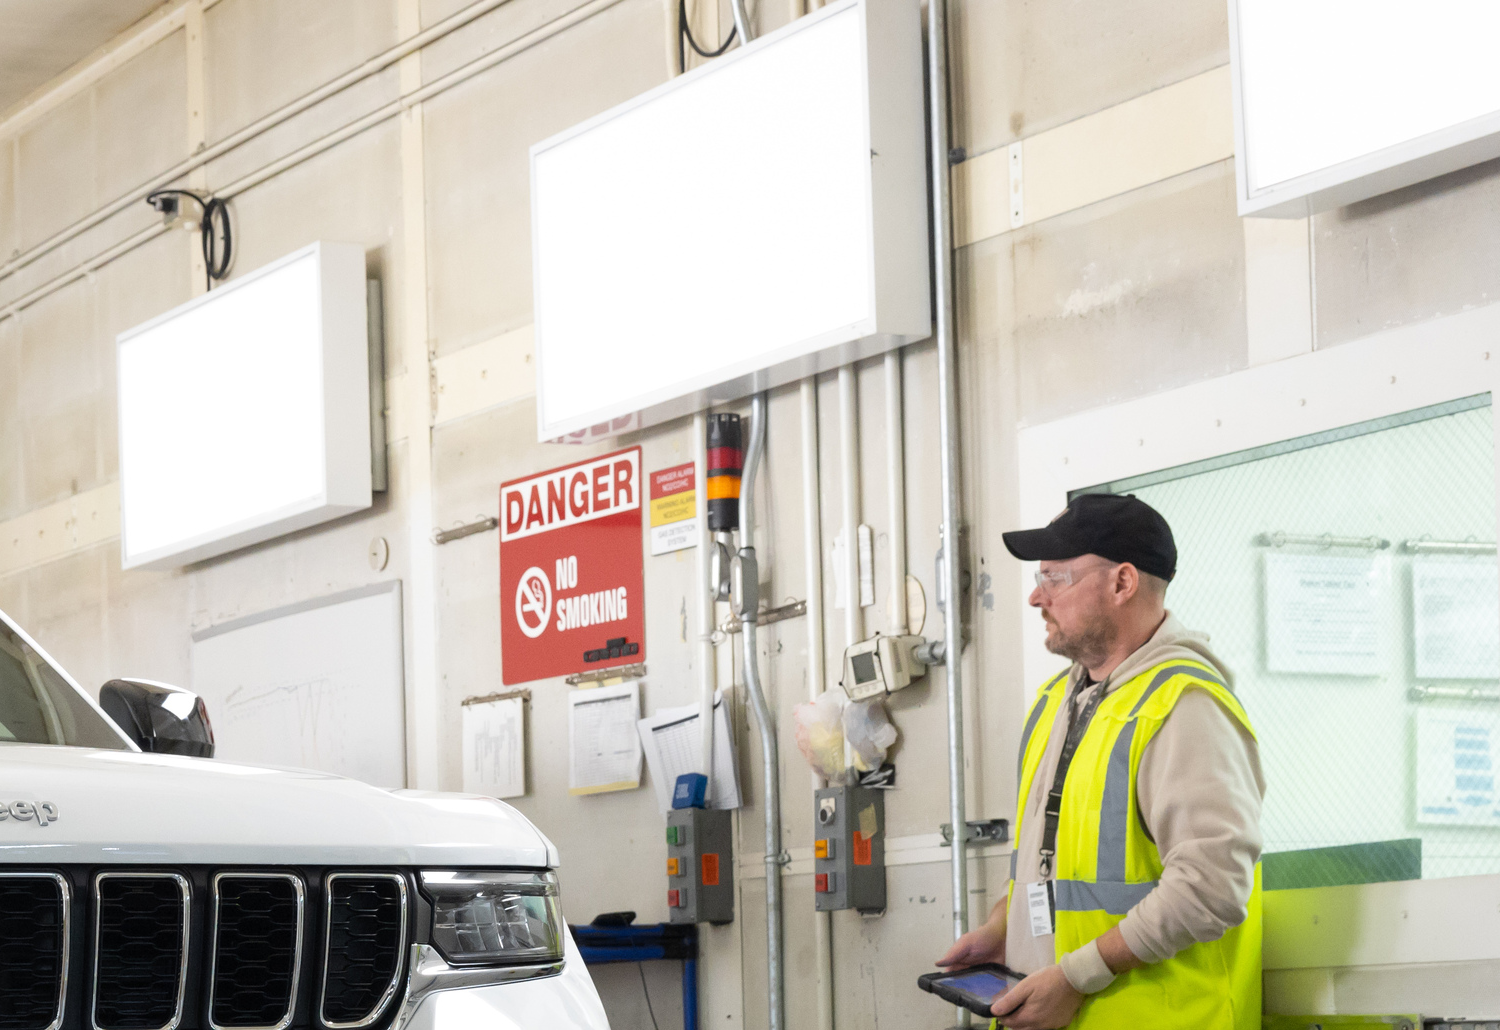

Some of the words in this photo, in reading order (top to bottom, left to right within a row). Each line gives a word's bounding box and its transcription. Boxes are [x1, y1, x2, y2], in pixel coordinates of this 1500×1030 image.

[506, 459, 634, 535] DANGER
[555, 555, 578, 591] NO
[556, 586, 627, 632] SMOKING
